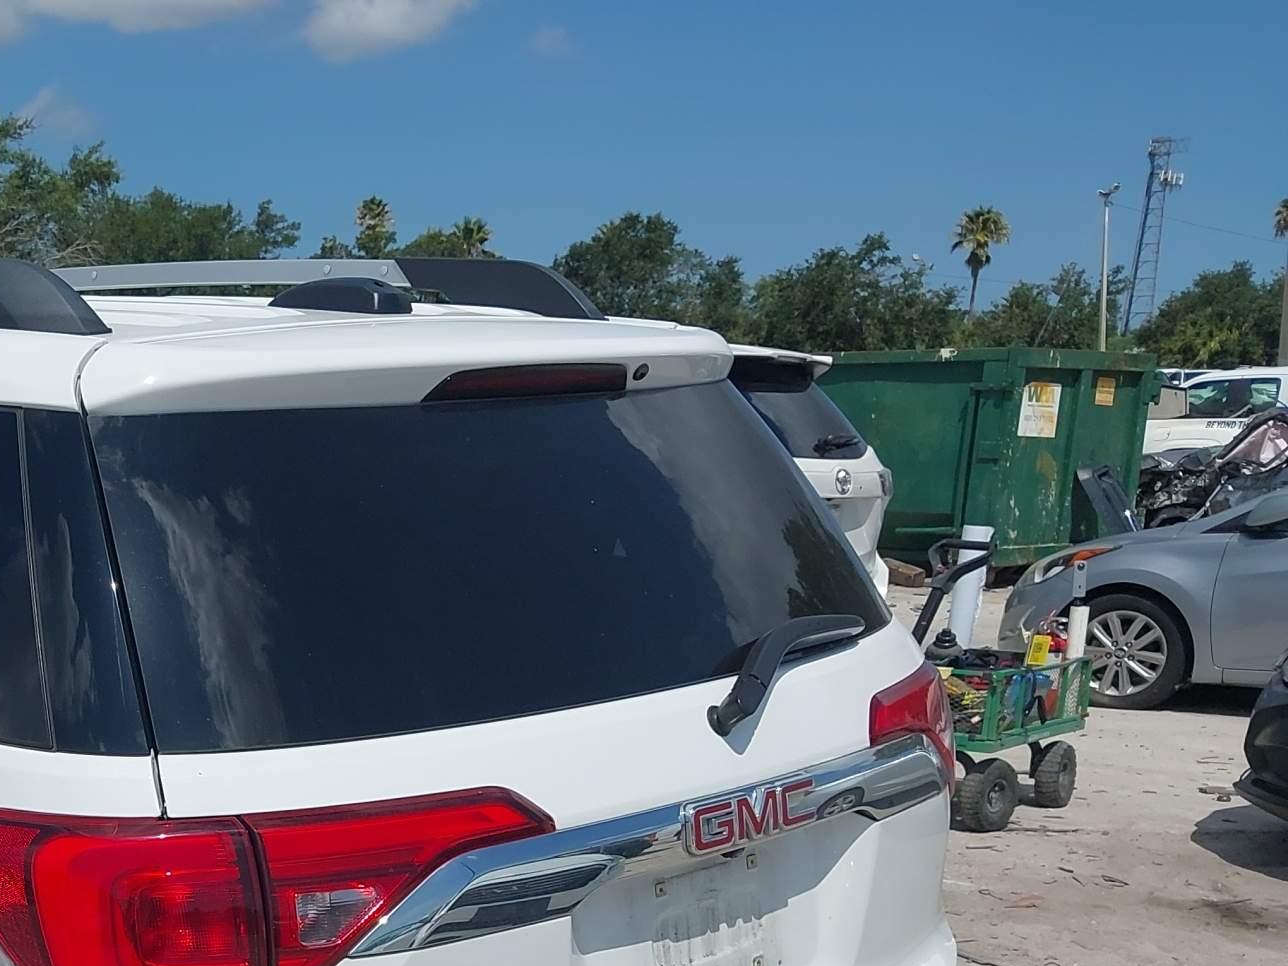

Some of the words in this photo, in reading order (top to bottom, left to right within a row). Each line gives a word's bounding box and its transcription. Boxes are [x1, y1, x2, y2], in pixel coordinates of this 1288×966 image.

[1205, 420, 1237, 429] BEYOND
[1237, 420, 1249, 430] TH
[691, 779, 818, 853] GMC
